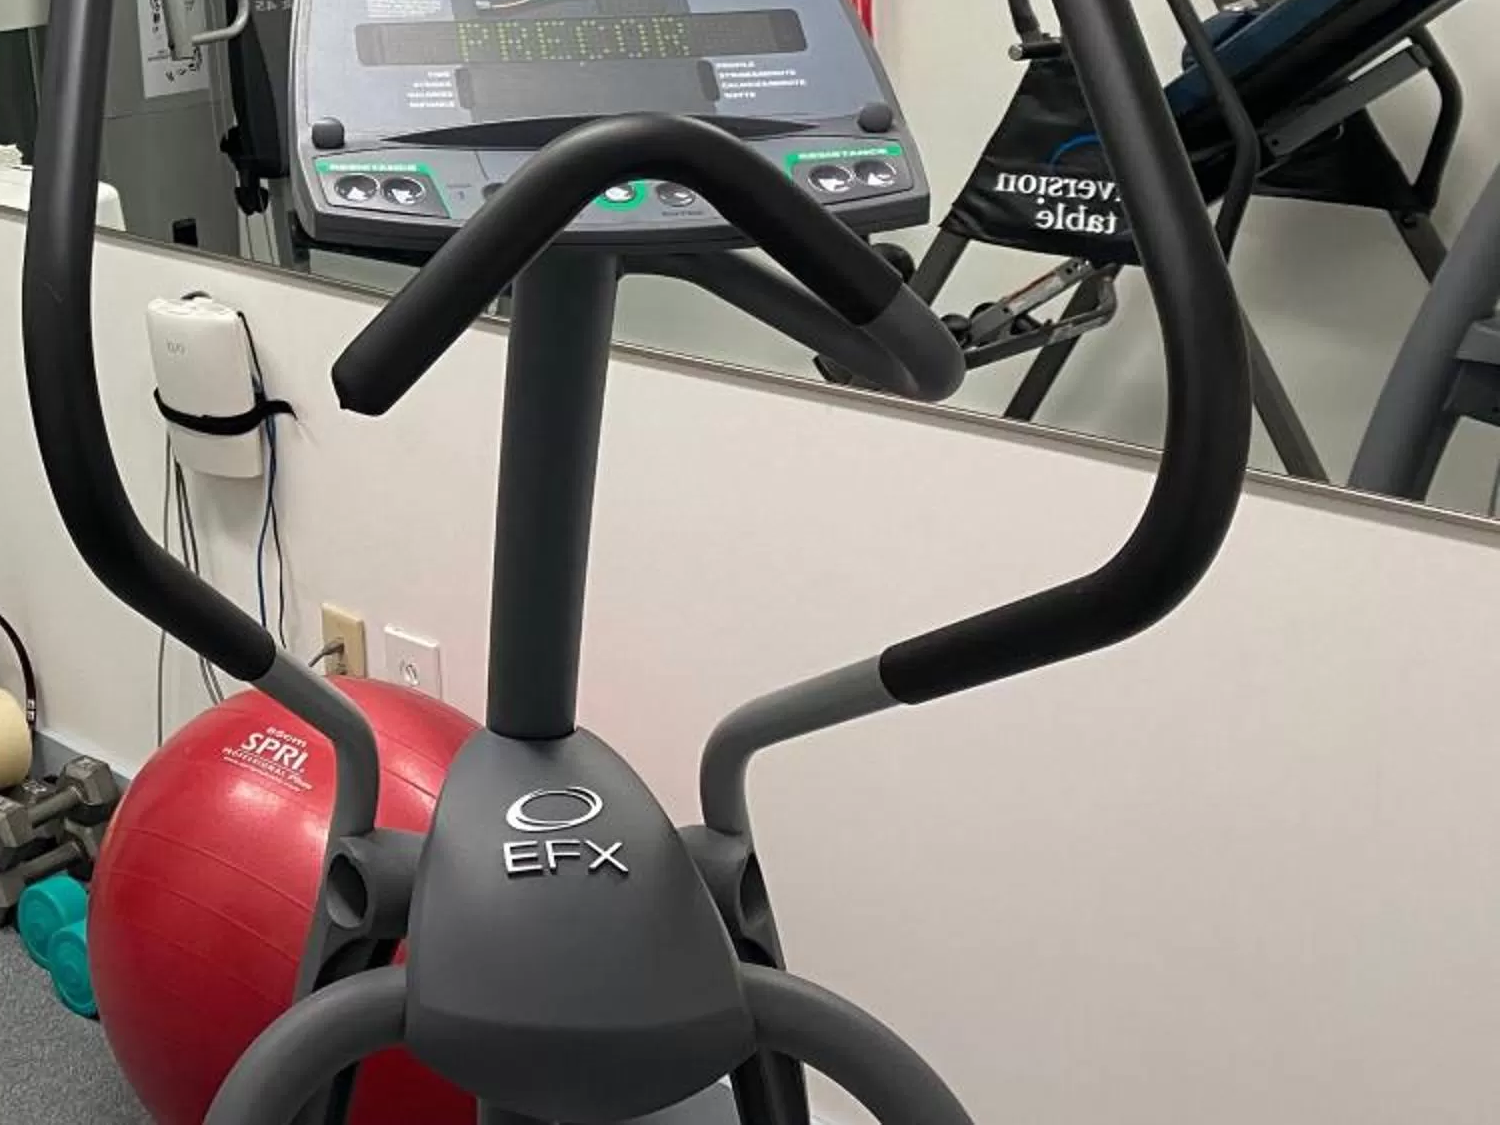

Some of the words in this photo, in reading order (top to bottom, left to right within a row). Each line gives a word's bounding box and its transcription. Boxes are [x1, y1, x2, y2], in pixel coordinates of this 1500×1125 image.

[457, 18, 690, 63] PRECOR
[240, 731, 309, 770] SPRI
[503, 839, 629, 873] EFX
